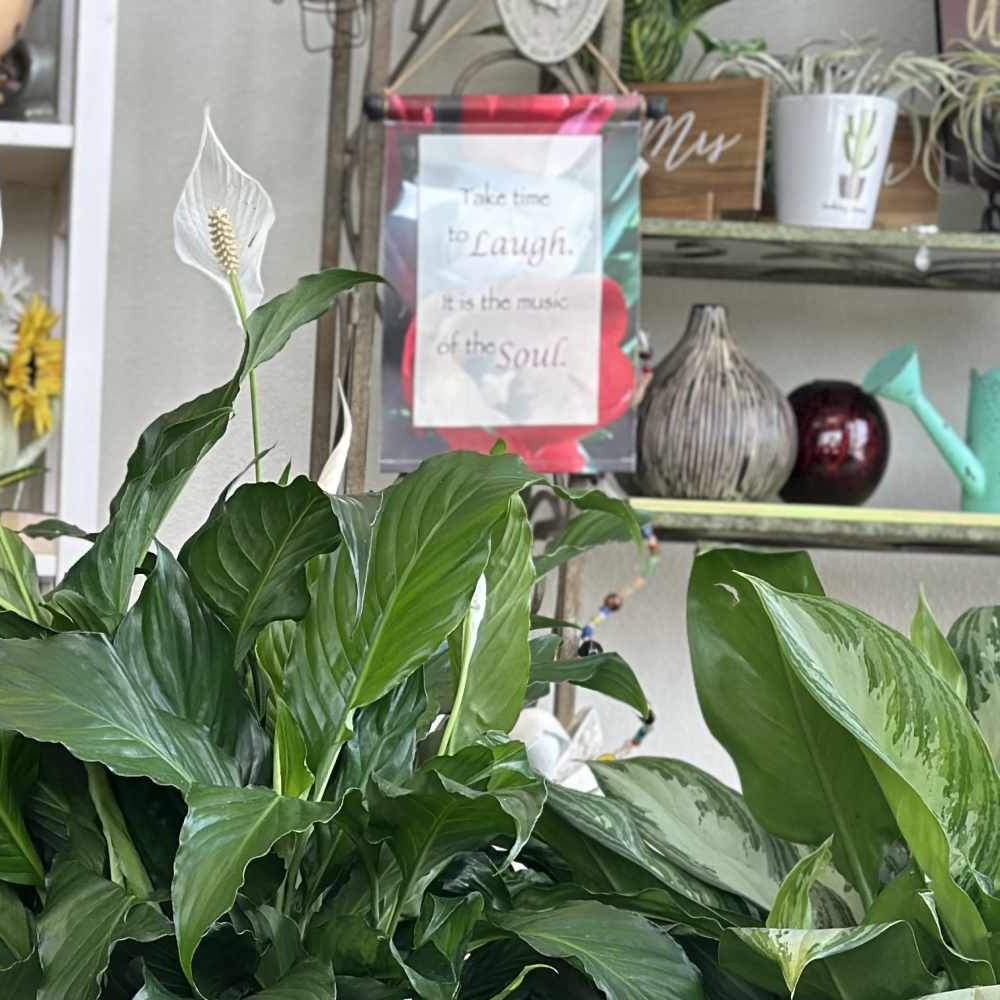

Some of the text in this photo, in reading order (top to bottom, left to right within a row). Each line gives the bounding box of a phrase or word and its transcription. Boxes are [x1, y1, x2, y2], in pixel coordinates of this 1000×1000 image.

[640, 110, 743, 172] Mrs
[459, 181, 551, 206] Take time
[447, 225, 574, 267] to Laugh.
[441, 287, 569, 312] It is the music
[437, 330, 569, 369] of the Soul.
